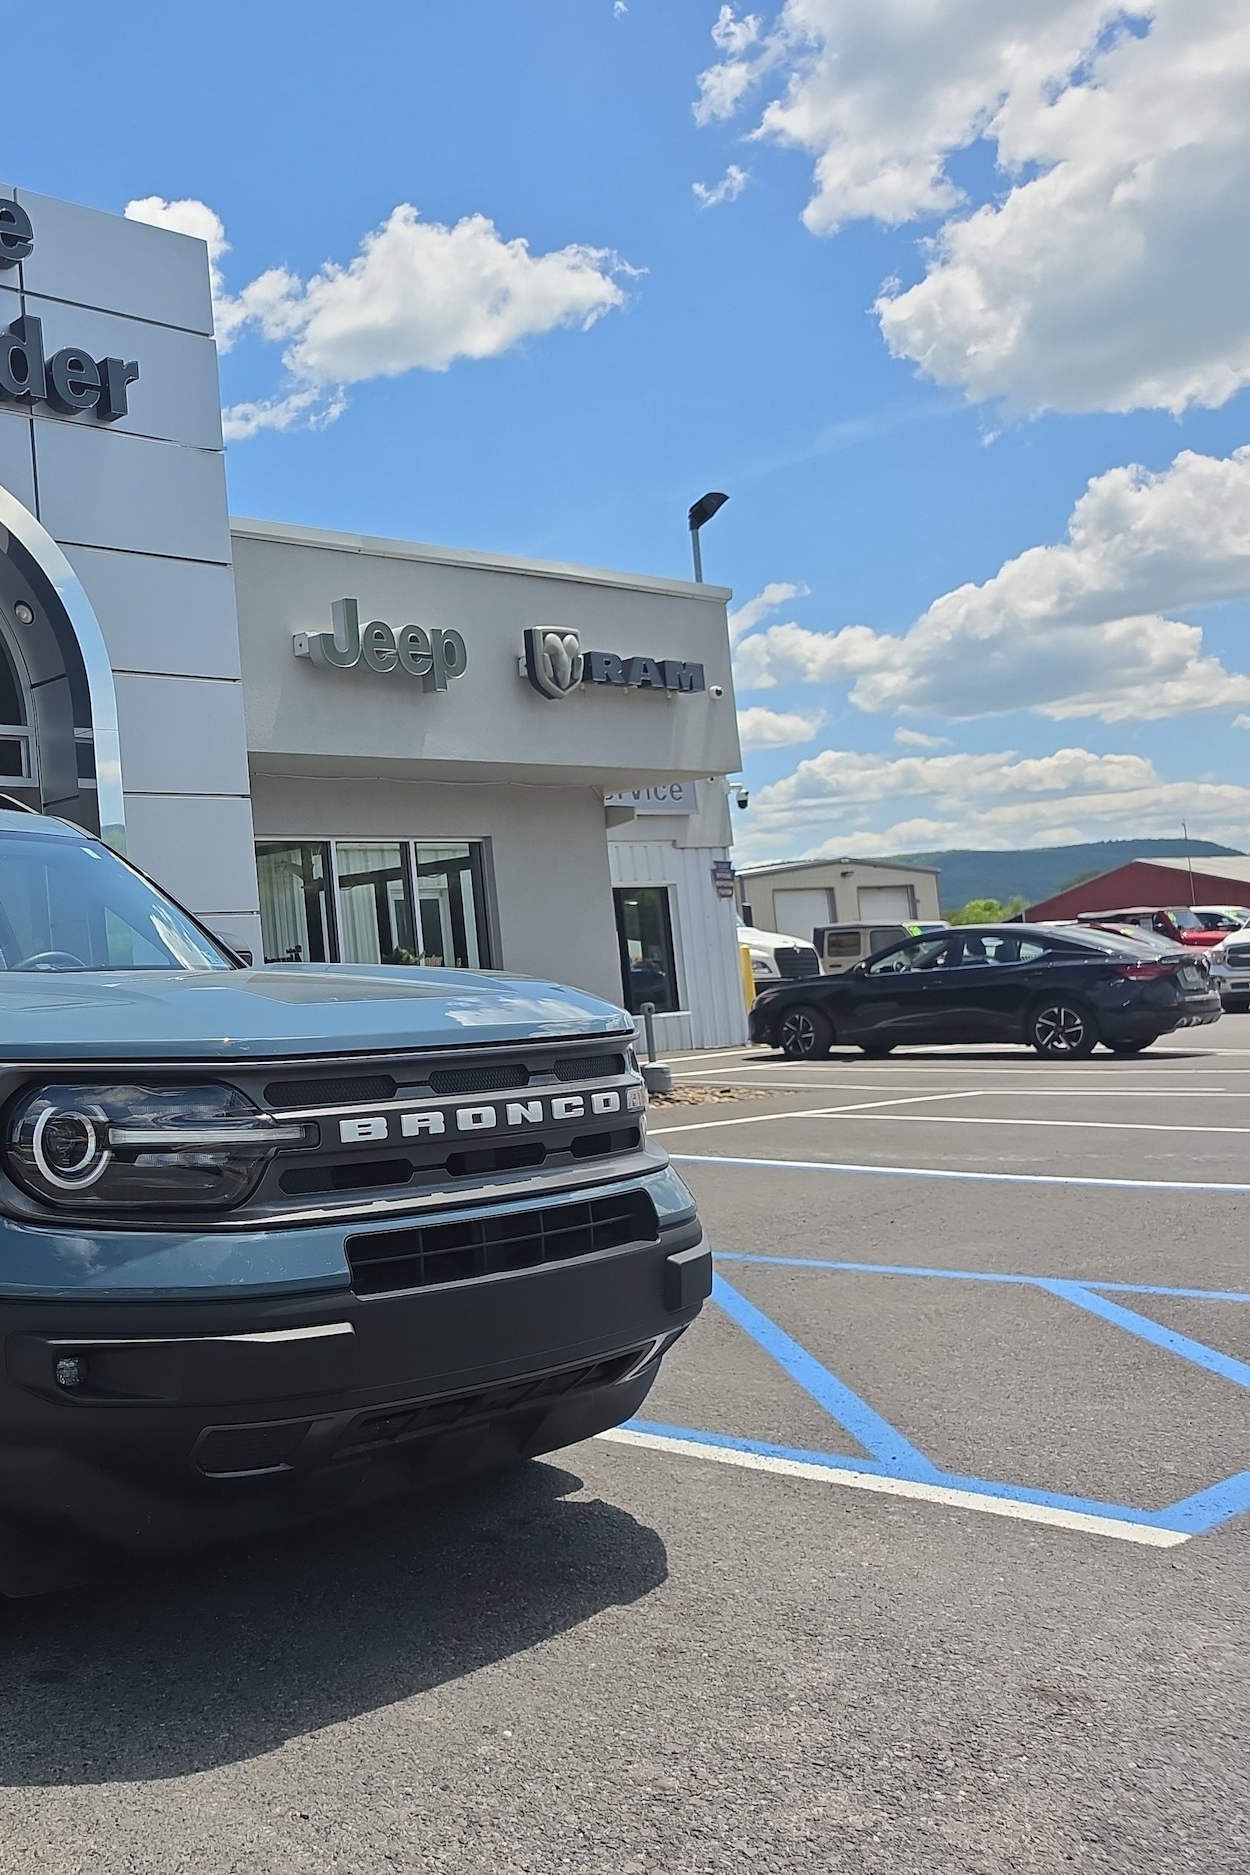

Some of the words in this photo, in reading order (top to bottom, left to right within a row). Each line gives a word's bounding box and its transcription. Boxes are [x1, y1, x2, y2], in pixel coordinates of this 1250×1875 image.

[312, 598, 467, 692] Jeep
[588, 651, 706, 693] RAM
[339, 1091, 620, 1144] BRONCO
